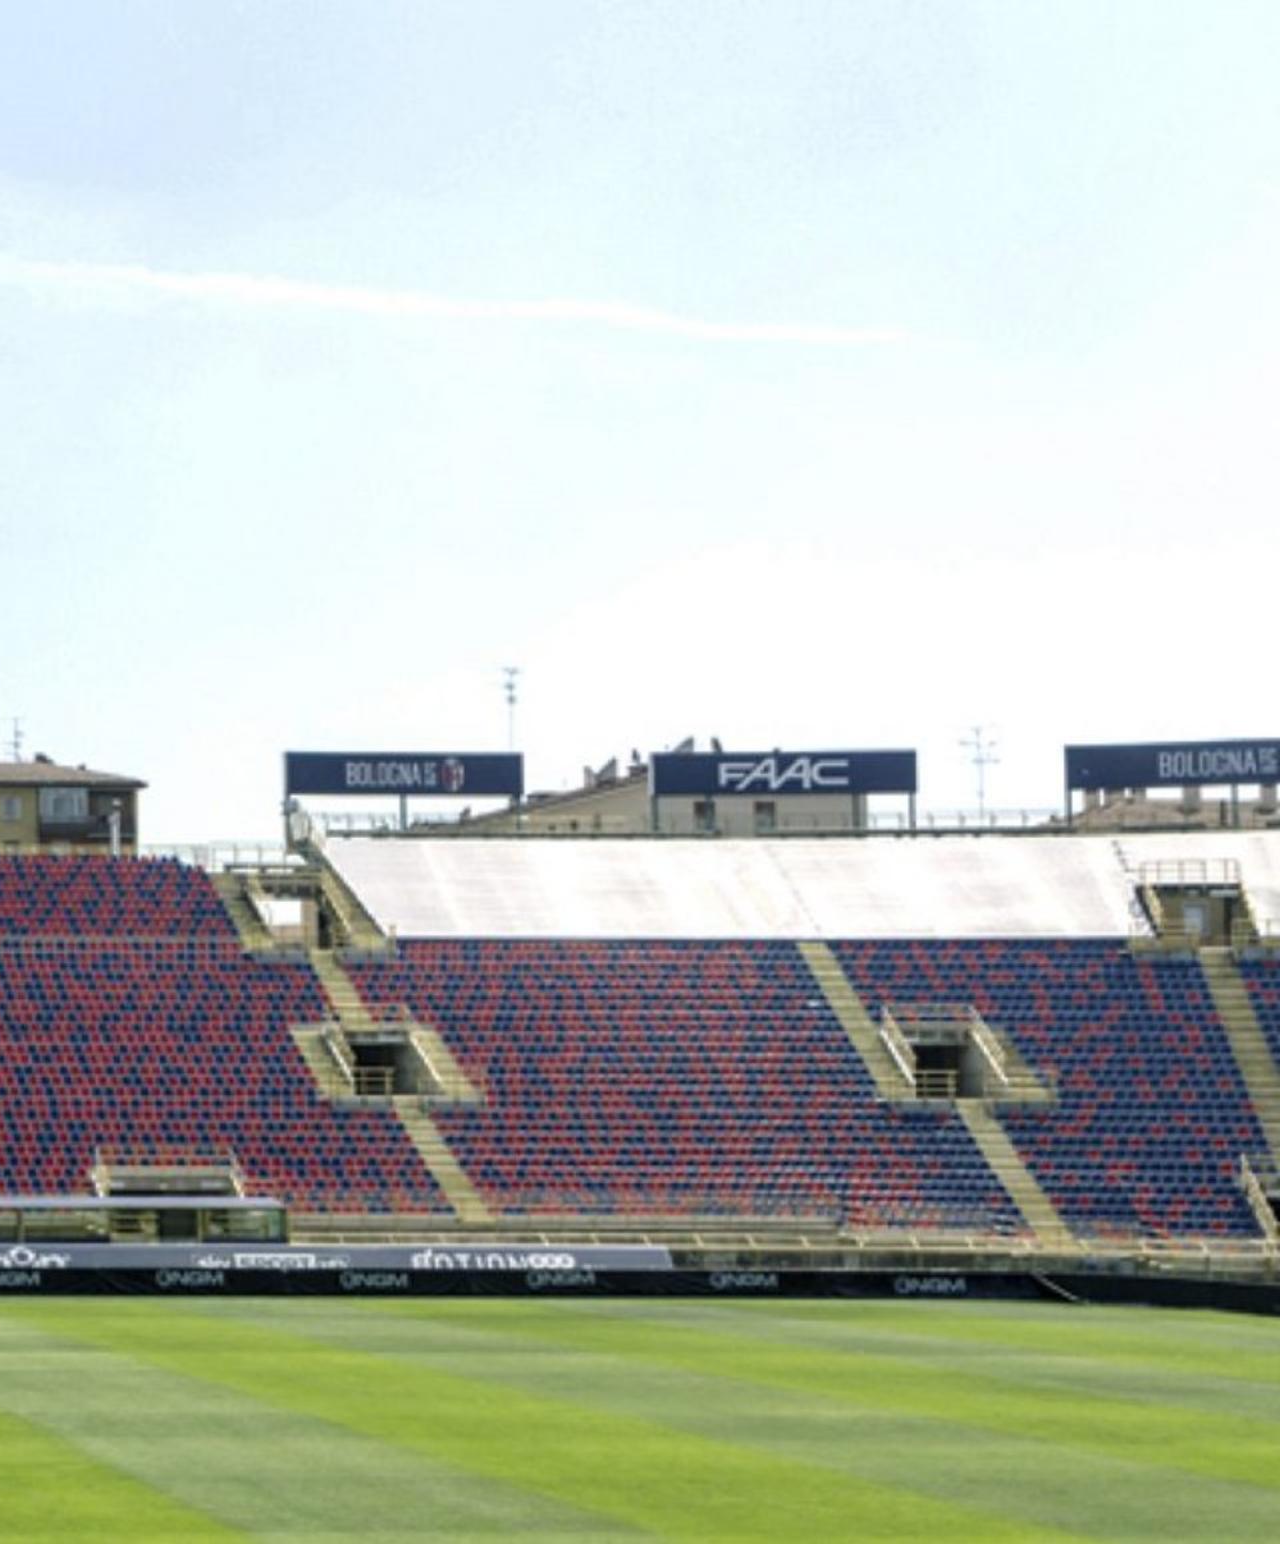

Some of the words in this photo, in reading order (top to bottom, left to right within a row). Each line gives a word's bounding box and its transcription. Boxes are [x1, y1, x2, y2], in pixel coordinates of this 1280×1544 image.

[345, 762, 421, 787] BOLOGNA
[717, 757, 849, 790] FAAC
[1158, 748, 1257, 778] BOLOGNA
